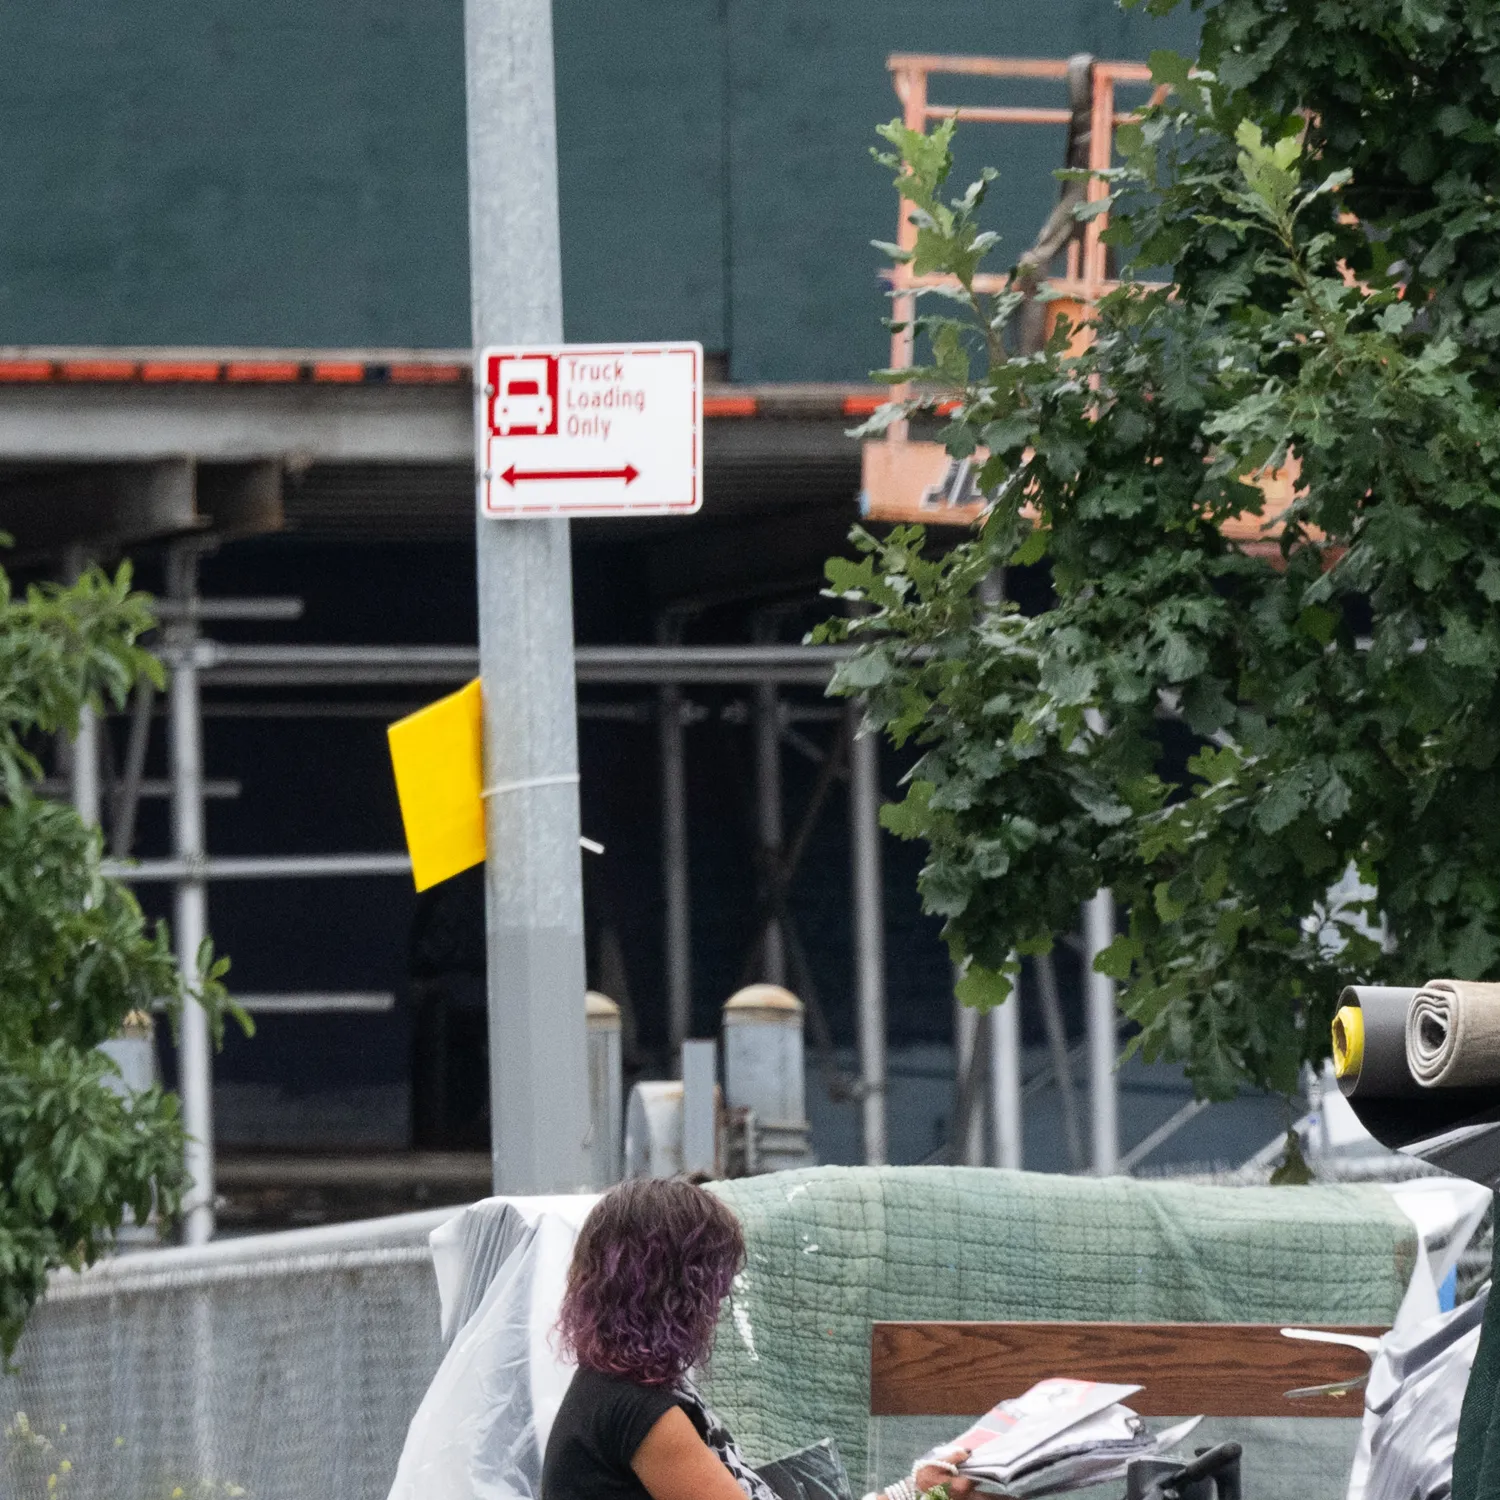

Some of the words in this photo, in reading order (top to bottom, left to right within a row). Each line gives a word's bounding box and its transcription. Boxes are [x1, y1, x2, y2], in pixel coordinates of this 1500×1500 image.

[567, 360, 625, 382] Truck
[566, 387, 646, 412] Loading
[566, 414, 612, 441] Only
